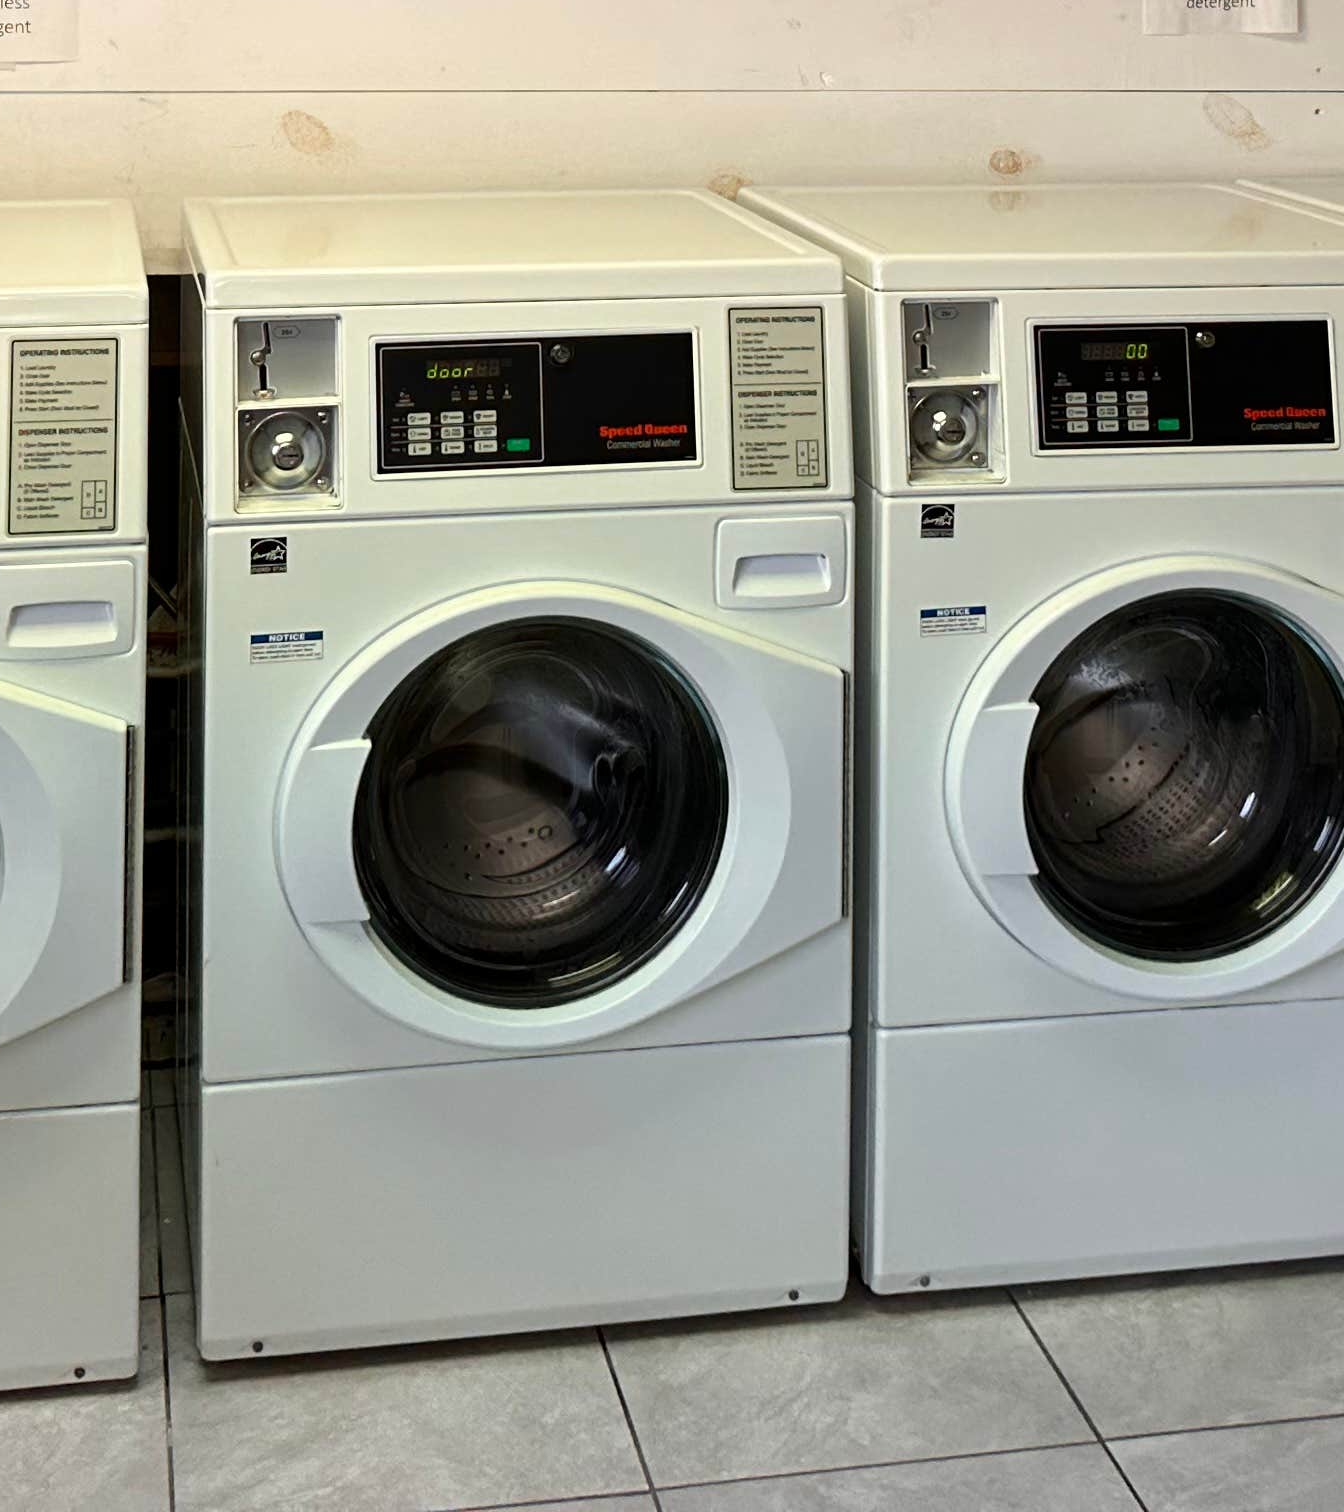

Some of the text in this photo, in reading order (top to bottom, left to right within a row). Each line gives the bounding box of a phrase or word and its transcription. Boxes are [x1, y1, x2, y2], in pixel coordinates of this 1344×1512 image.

[426, 362, 473, 379] door
[1243, 407, 1326, 420] Speed Queen
[599, 424, 687, 439] Speed Queen
[937, 607, 970, 617] NOTICE
[269, 633, 305, 643] NOTICE
